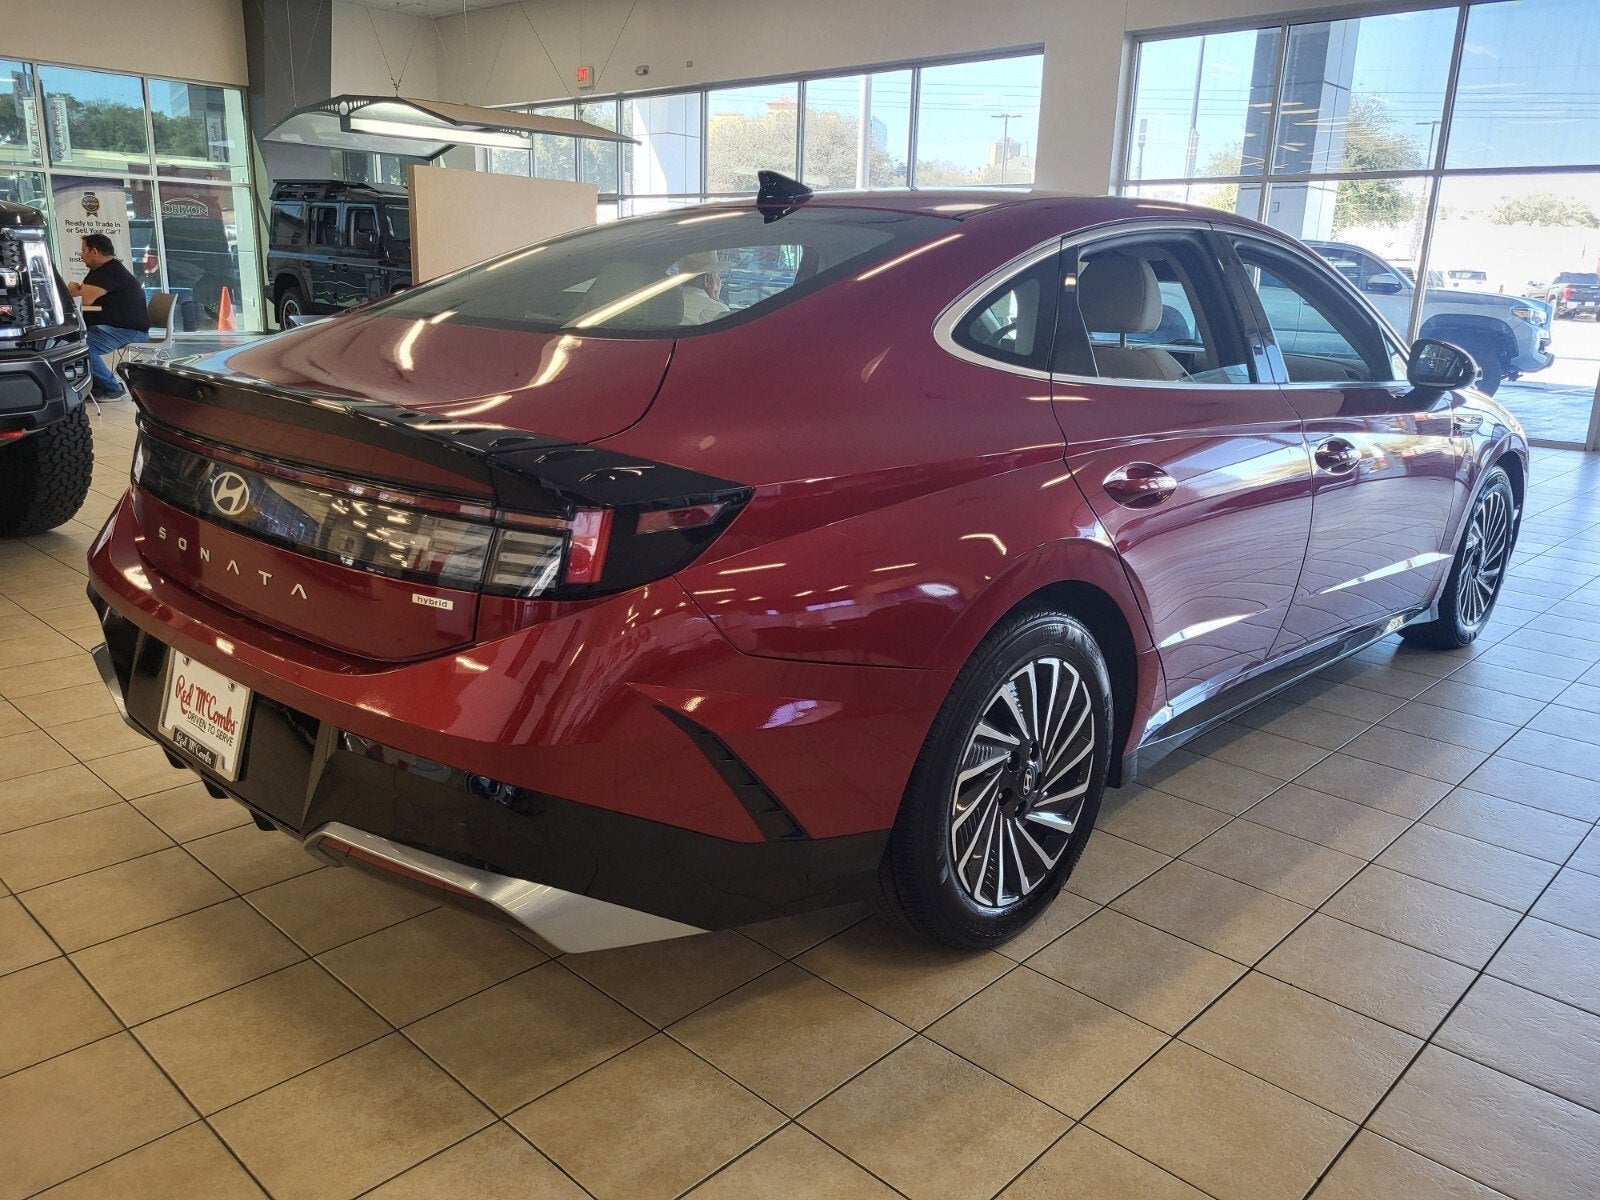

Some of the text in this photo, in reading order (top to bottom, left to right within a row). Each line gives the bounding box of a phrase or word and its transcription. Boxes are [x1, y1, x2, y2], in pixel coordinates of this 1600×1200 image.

[65, 220, 86, 228] Ready
[158, 526, 308, 600] SONATA
[416, 595, 448, 608] hybrid
[175, 674, 236, 735] Red McCombs
[187, 710, 234, 747] DRIVEN TO SERVE
[176, 731, 212, 765] Red McCombs
